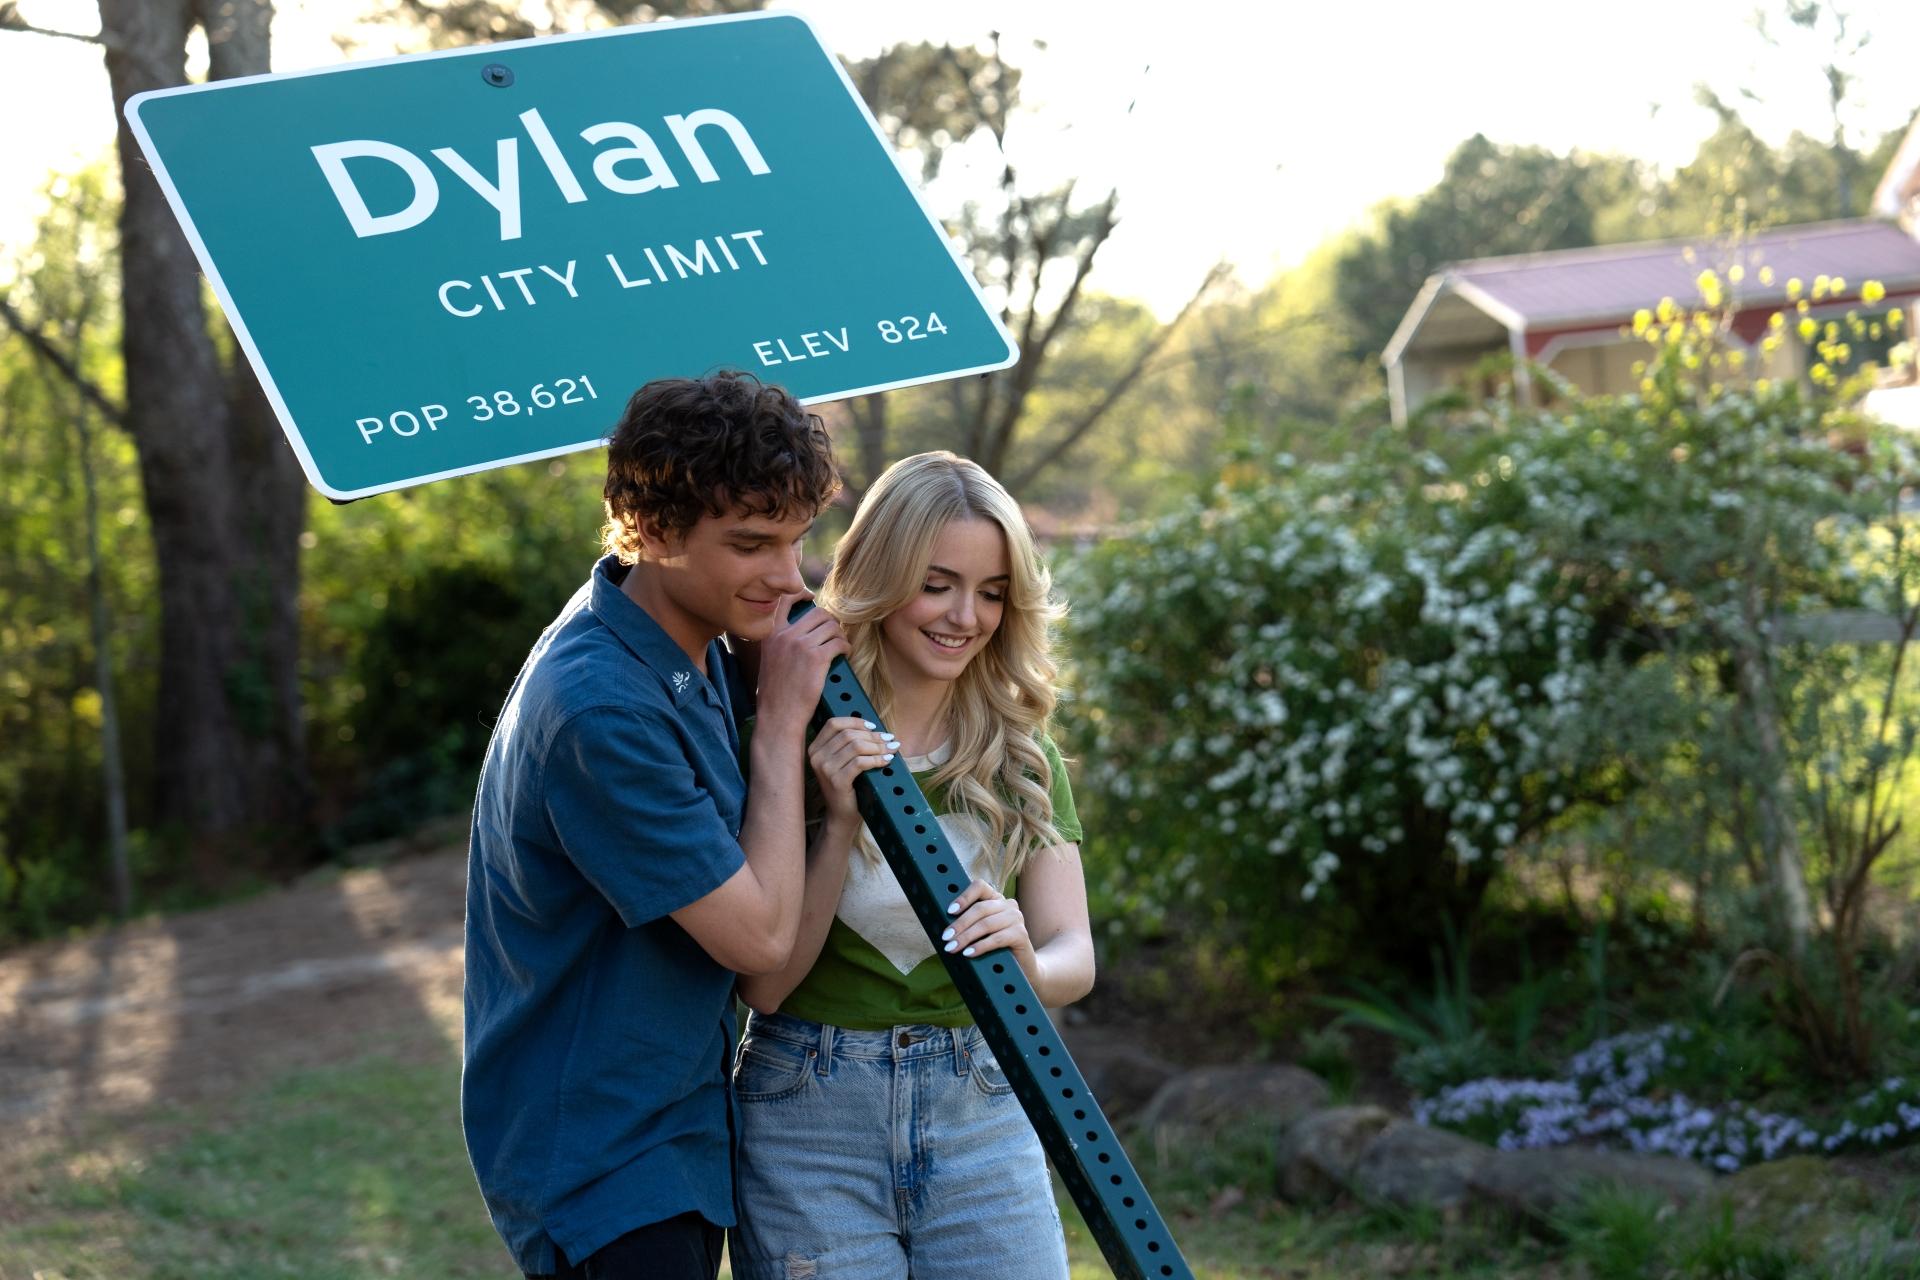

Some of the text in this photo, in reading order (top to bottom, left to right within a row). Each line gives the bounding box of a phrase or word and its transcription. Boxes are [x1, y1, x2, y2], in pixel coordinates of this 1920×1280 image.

[310, 107, 771, 241] Dylan
[438, 229, 768, 317] CITY LIMIT
[752, 312, 948, 367] ELEV 824
[356, 375, 598, 445] POP 38,621
